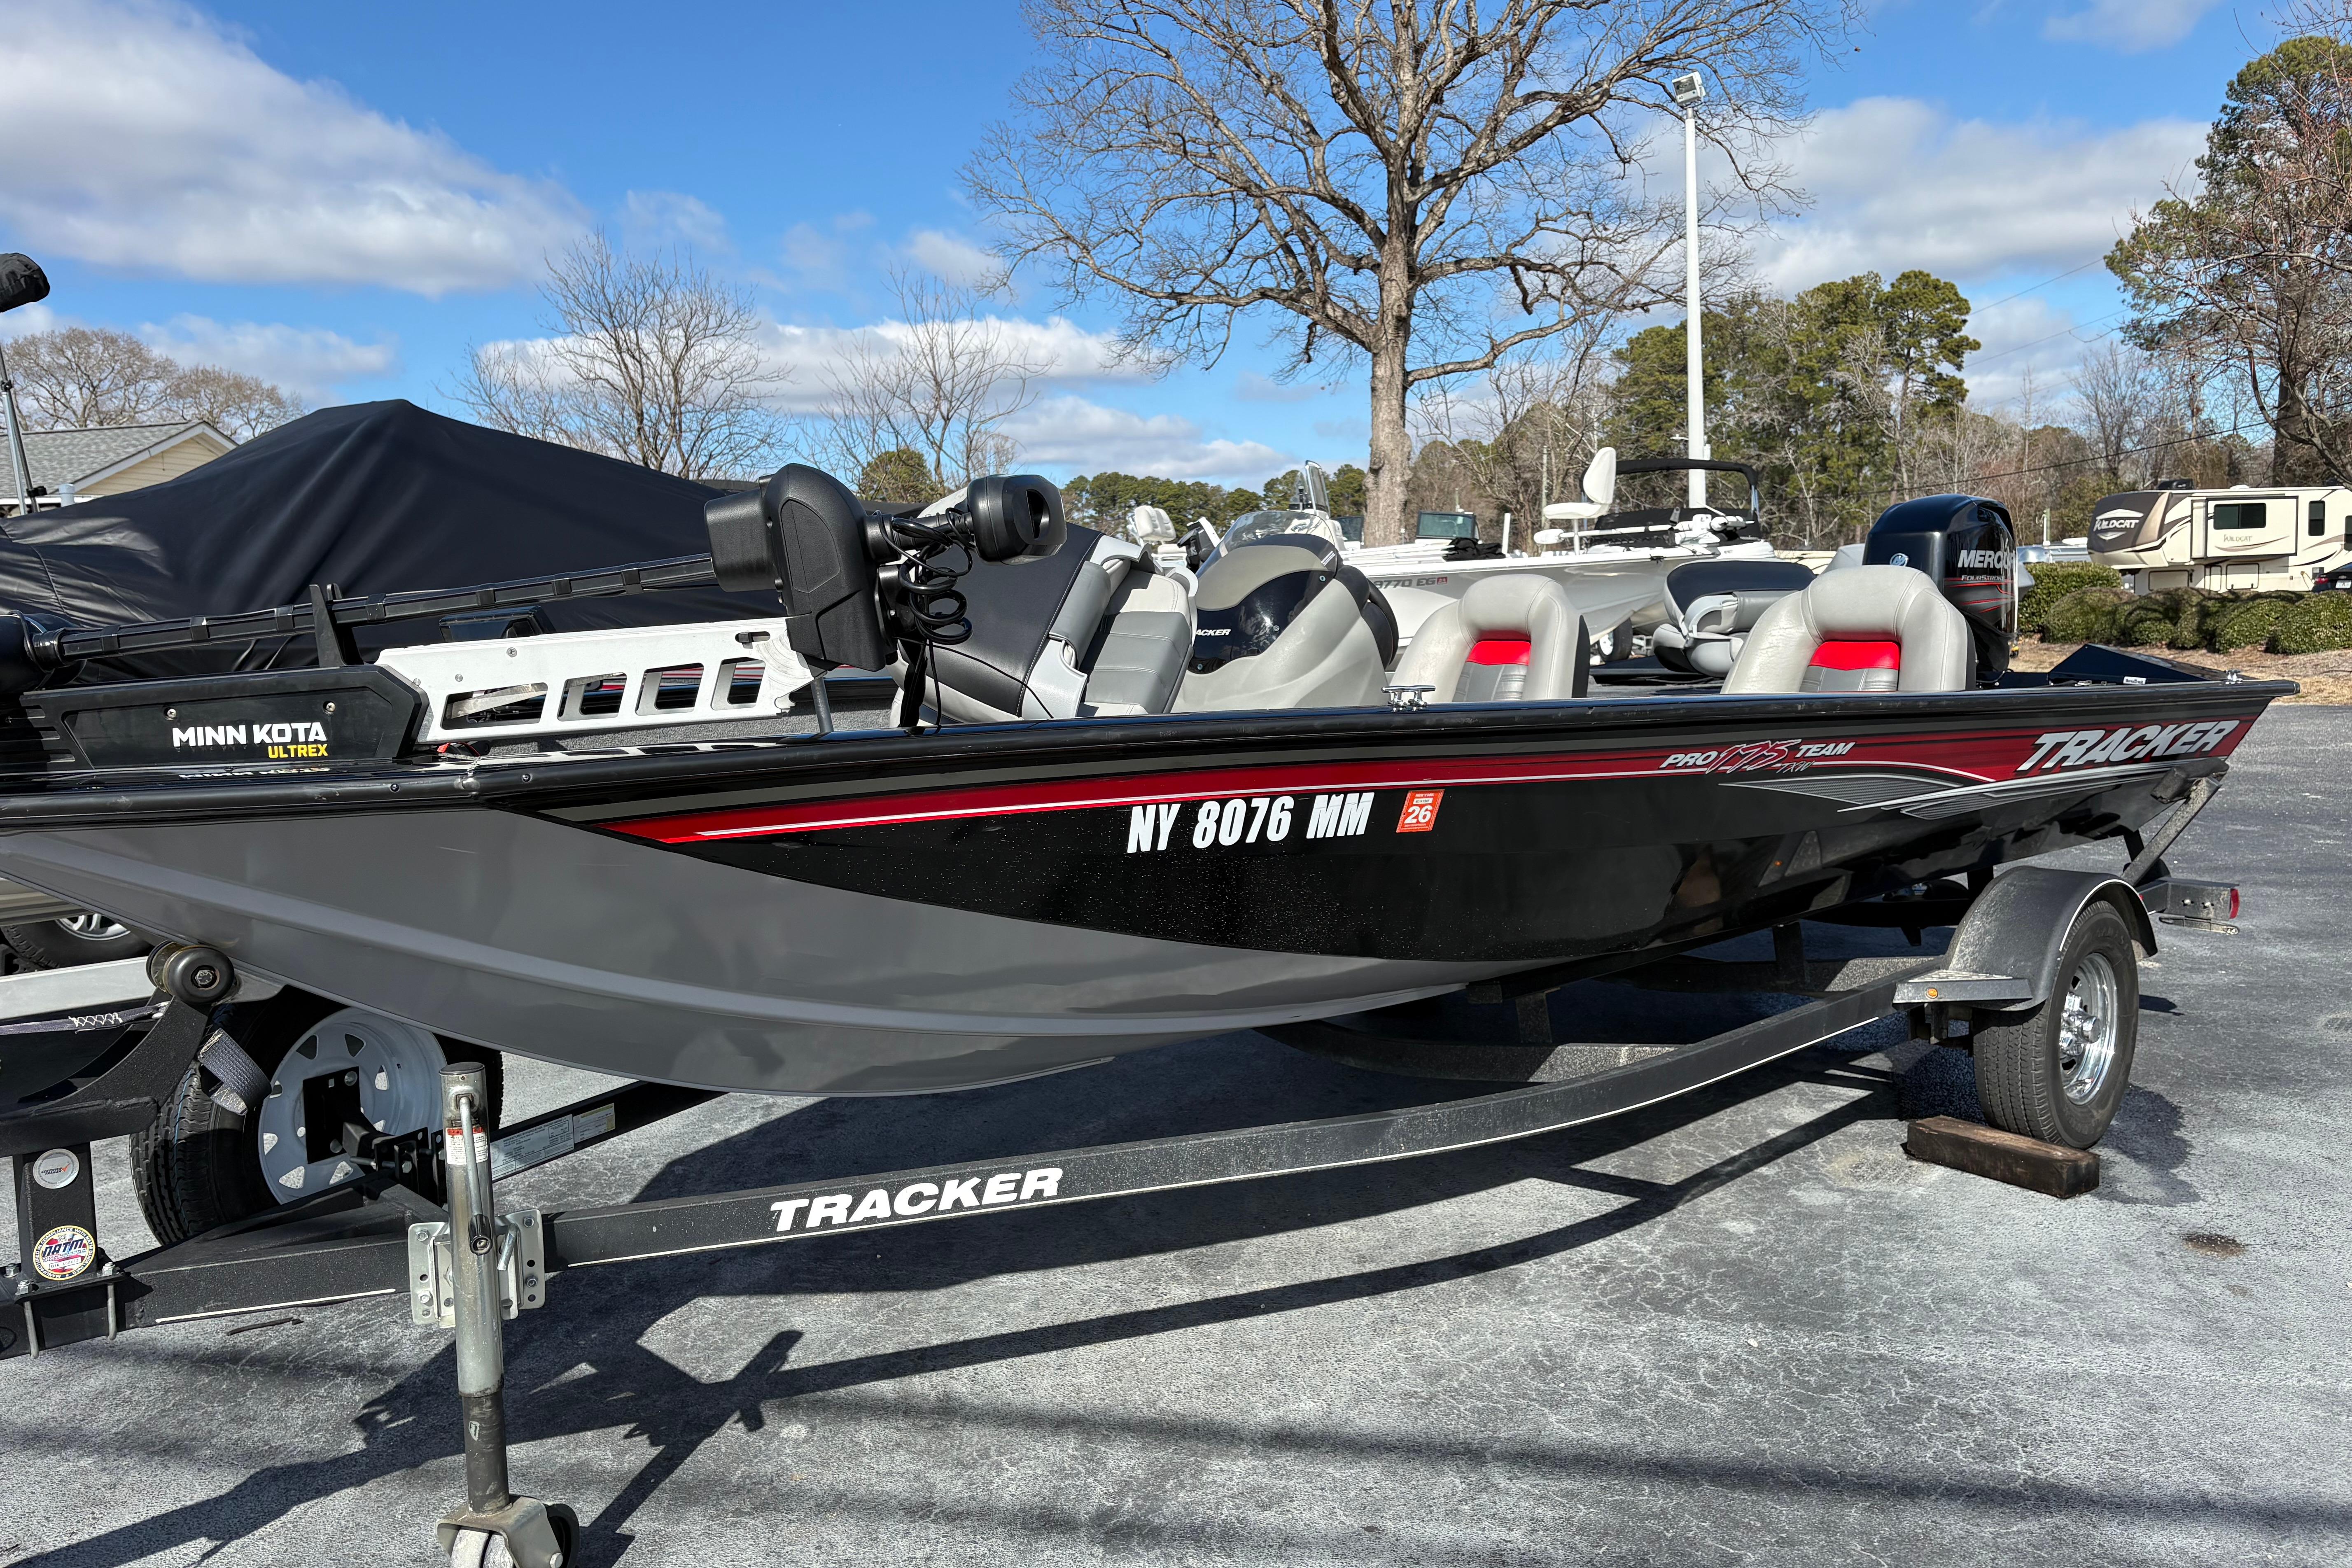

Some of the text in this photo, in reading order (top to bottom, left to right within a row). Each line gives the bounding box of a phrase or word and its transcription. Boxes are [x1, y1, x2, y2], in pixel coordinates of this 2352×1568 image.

[2093, 519, 2140, 531] WILDCAT
[1958, 550, 2016, 569] MERCUR
[1416, 577, 1436, 586] EG
[172, 722, 327, 747] MINN KOTA
[268, 744, 328, 758] ULTREX
[2016, 720, 2240, 770] TRACKER
[1659, 739, 1856, 774] PRO 175 TEAM
[1127, 792, 1374, 854] NY 8076 MM
[1404, 805, 1433, 824] 26
[770, 1167, 1063, 1232] TRACKER
[41, 1227, 73, 1244] COMPLIANCE
[75, 1228, 87, 1237] WITH
[43, 1238, 84, 1257] NATM
